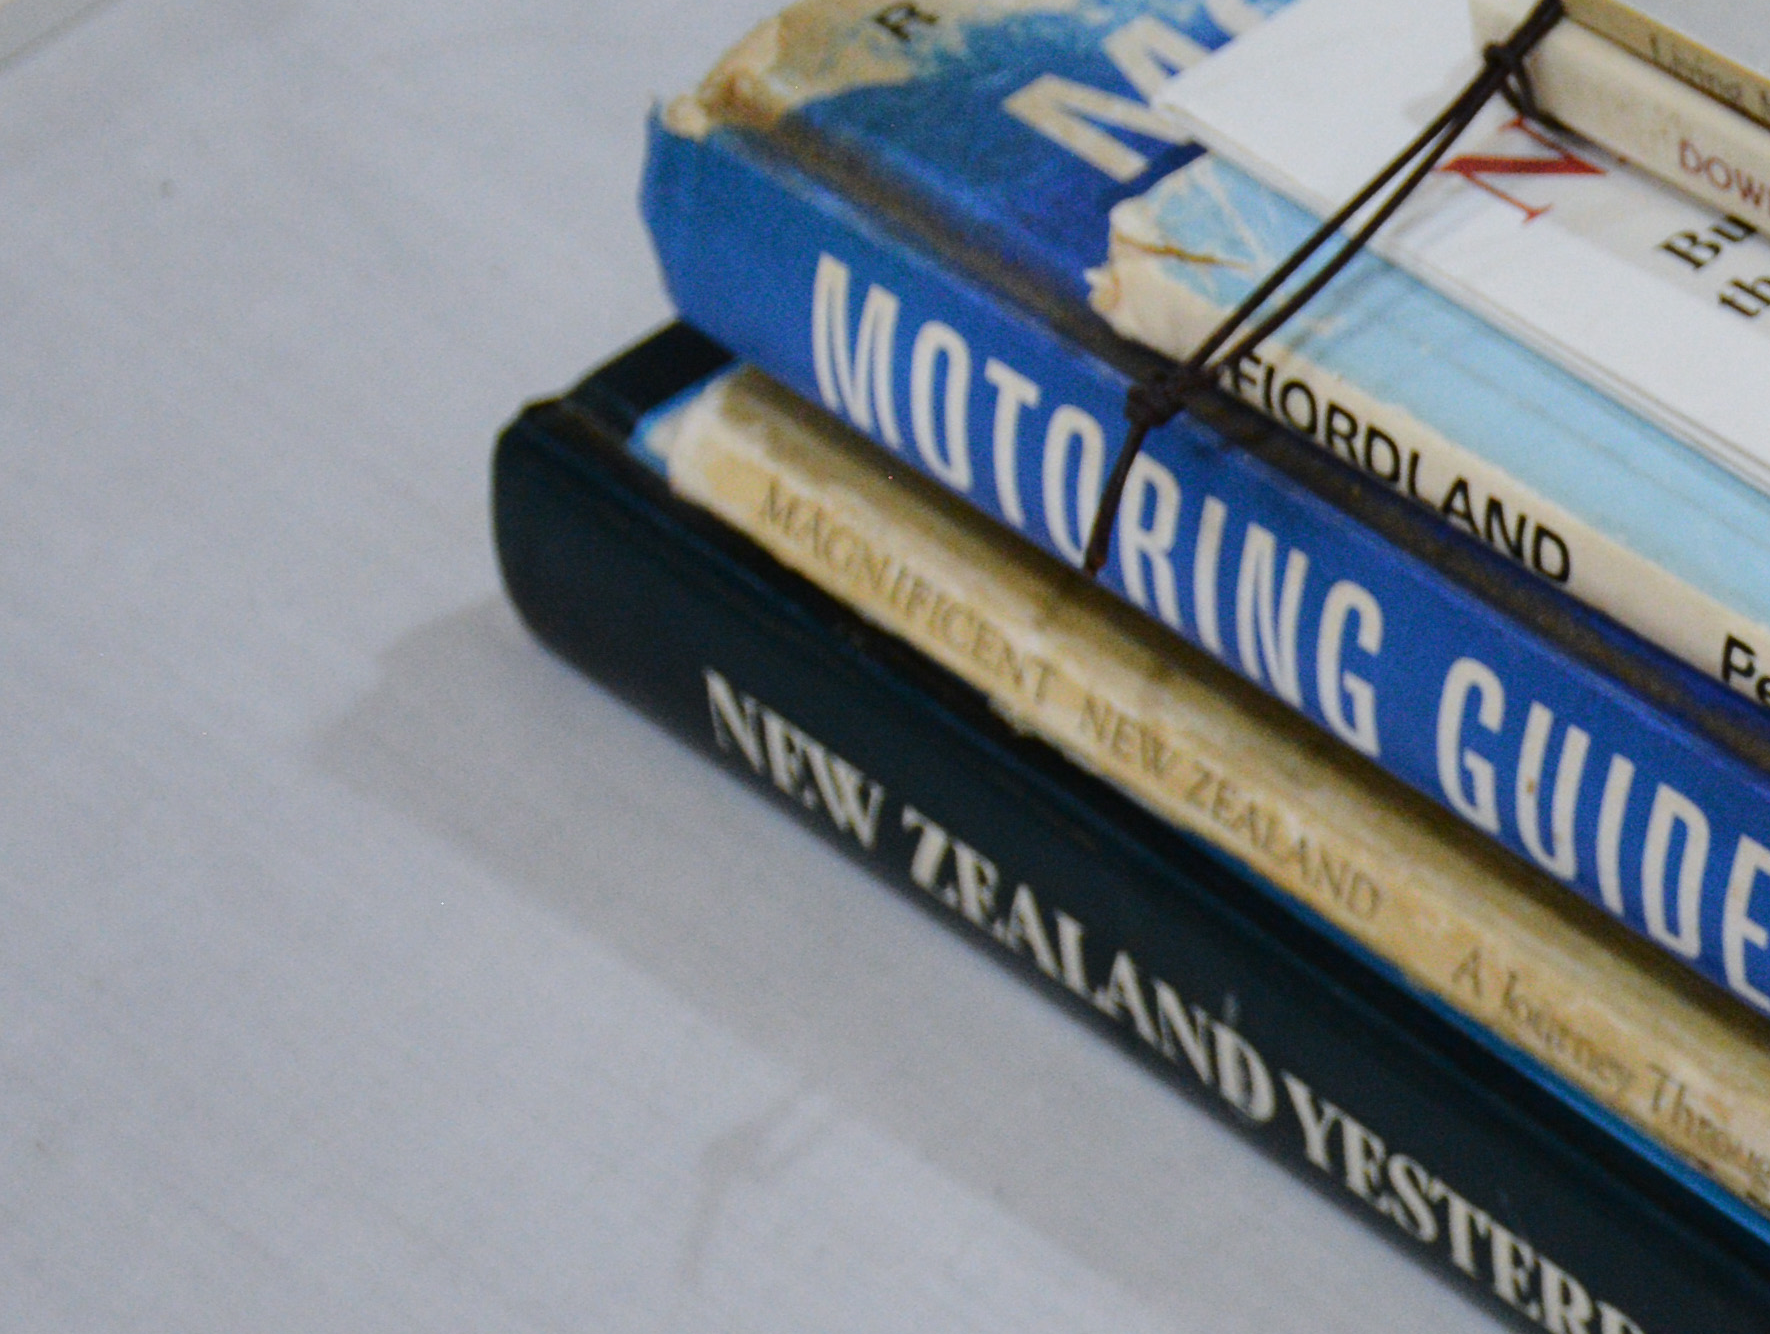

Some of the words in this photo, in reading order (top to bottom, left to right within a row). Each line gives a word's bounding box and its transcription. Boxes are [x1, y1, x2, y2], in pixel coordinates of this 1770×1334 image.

[811, 252, 1384, 758] MOTORING
[1229, 352, 1573, 585] FIORDLAND
[702, 666, 886, 851] NEW
[900, 802, 1277, 1124] ZEALAND
[760, 480, 1052, 708] MAGNIFICENT
[1079, 691, 1178, 777] NEW
[1188, 767, 1386, 923] ZEALAND
[1450, 945, 1487, 1001] A
